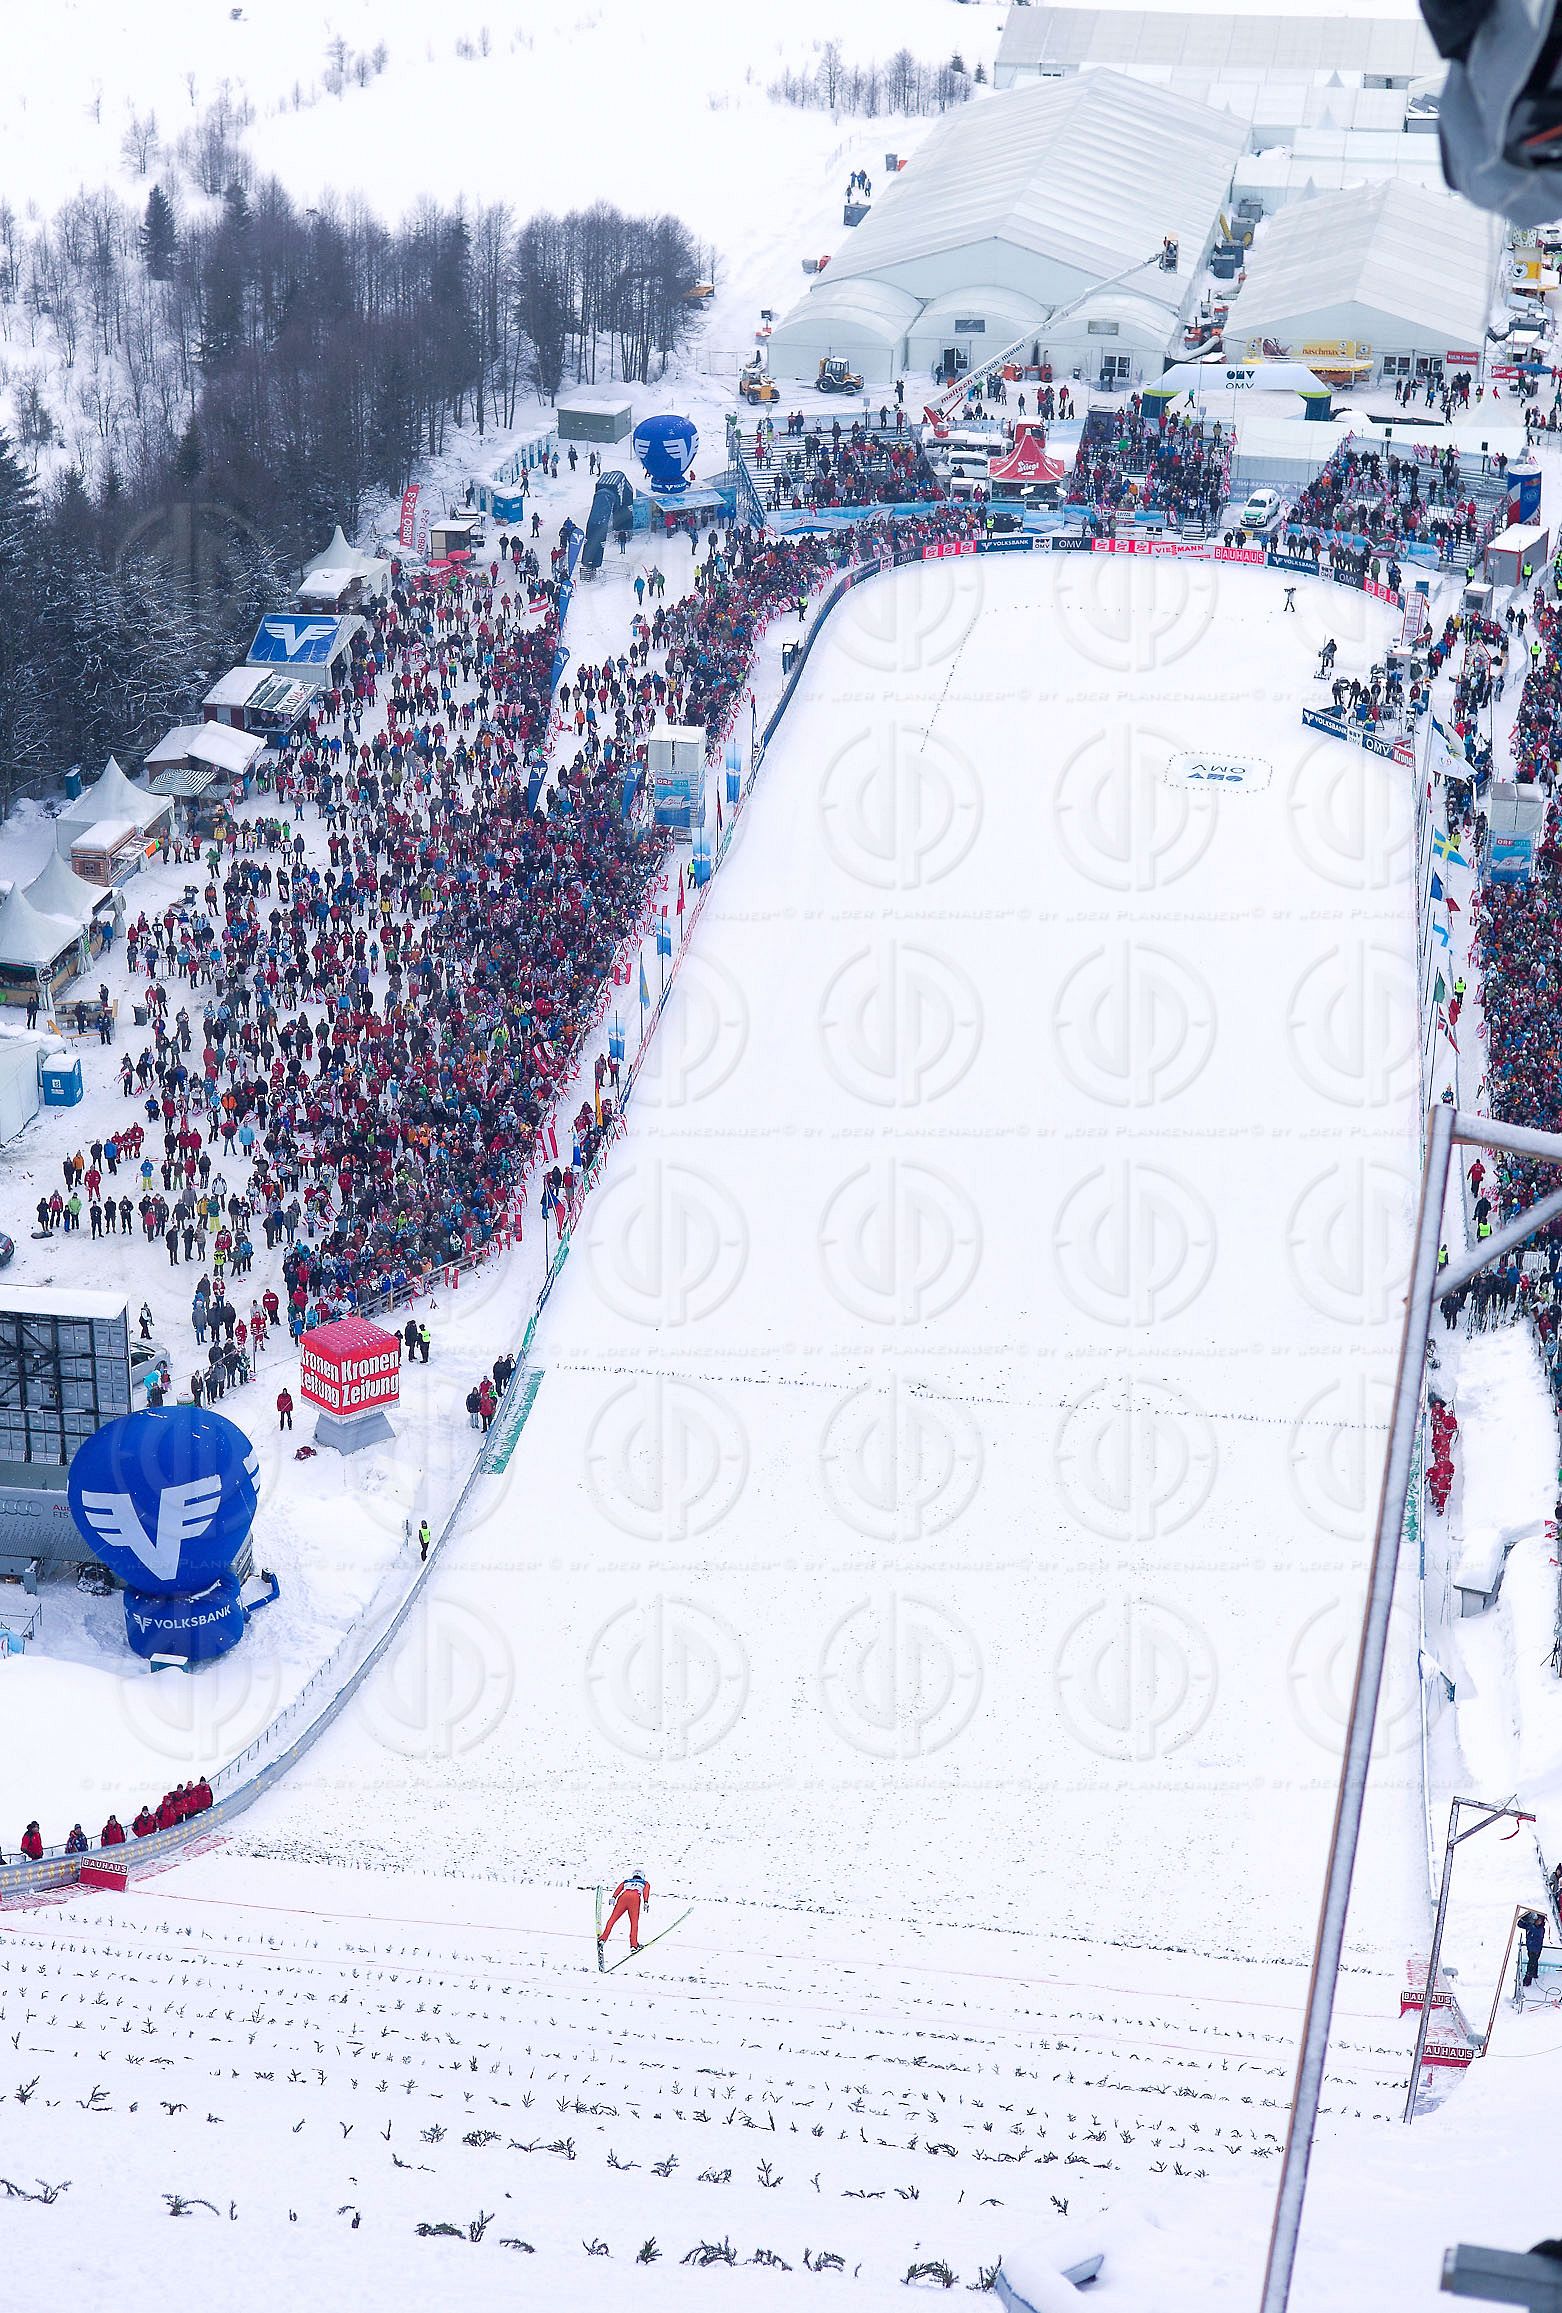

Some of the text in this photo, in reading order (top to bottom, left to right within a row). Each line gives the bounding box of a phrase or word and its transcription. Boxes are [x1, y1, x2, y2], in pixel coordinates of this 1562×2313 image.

[1225, 382, 1255, 390] OMV
[1059, 540, 1082, 549] OMV
[1215, 548, 1266, 565] BAUHAUS
[1339, 572, 1358, 585] OMV
[1366, 738, 1392, 757] OMV
[341, 1350, 399, 1383] Kronen
[341, 1373, 399, 1407] Zeitung
[154, 1604, 231, 1629] VOLKSBANK
[83, 1857, 128, 1873] BAUHAUS
[1403, 1991, 1452, 2004] BAUAUS
[1424, 2044, 1474, 2059] AUHAUS
